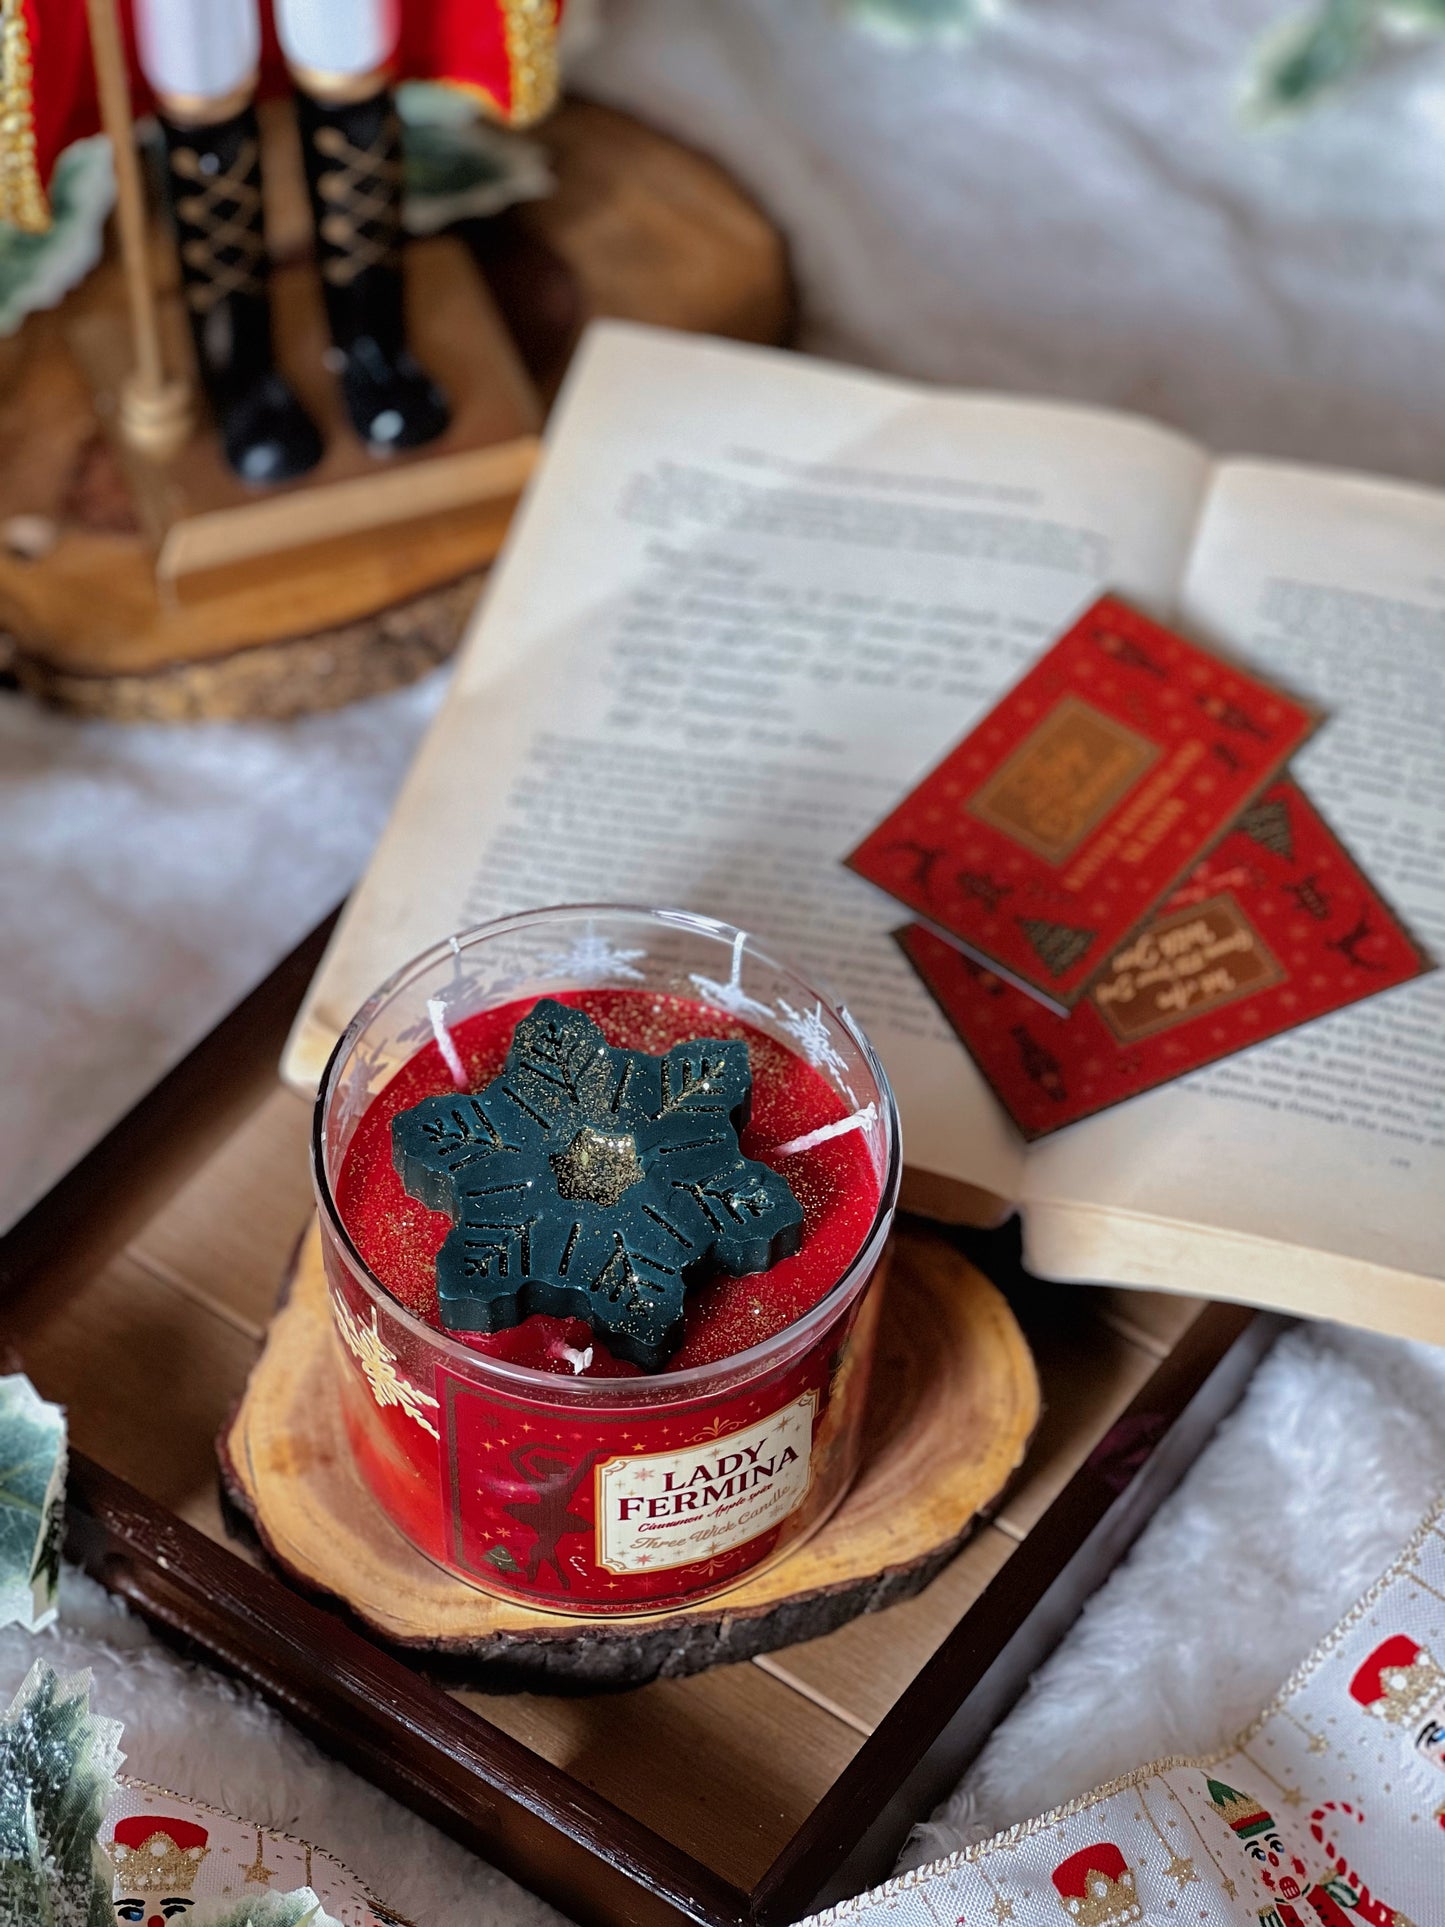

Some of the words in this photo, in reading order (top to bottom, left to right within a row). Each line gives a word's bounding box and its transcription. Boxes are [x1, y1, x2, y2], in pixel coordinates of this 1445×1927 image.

[618, 1446, 799, 1521] FERMINA
[663, 1437, 769, 1492] LADY
[629, 1536, 687, 1549] Three
[690, 1521, 737, 1542] Wick
[738, 1486, 790, 1525] Candle
[638, 1514, 704, 1532] Cinnamon
[707, 1496, 746, 1518] Apple
